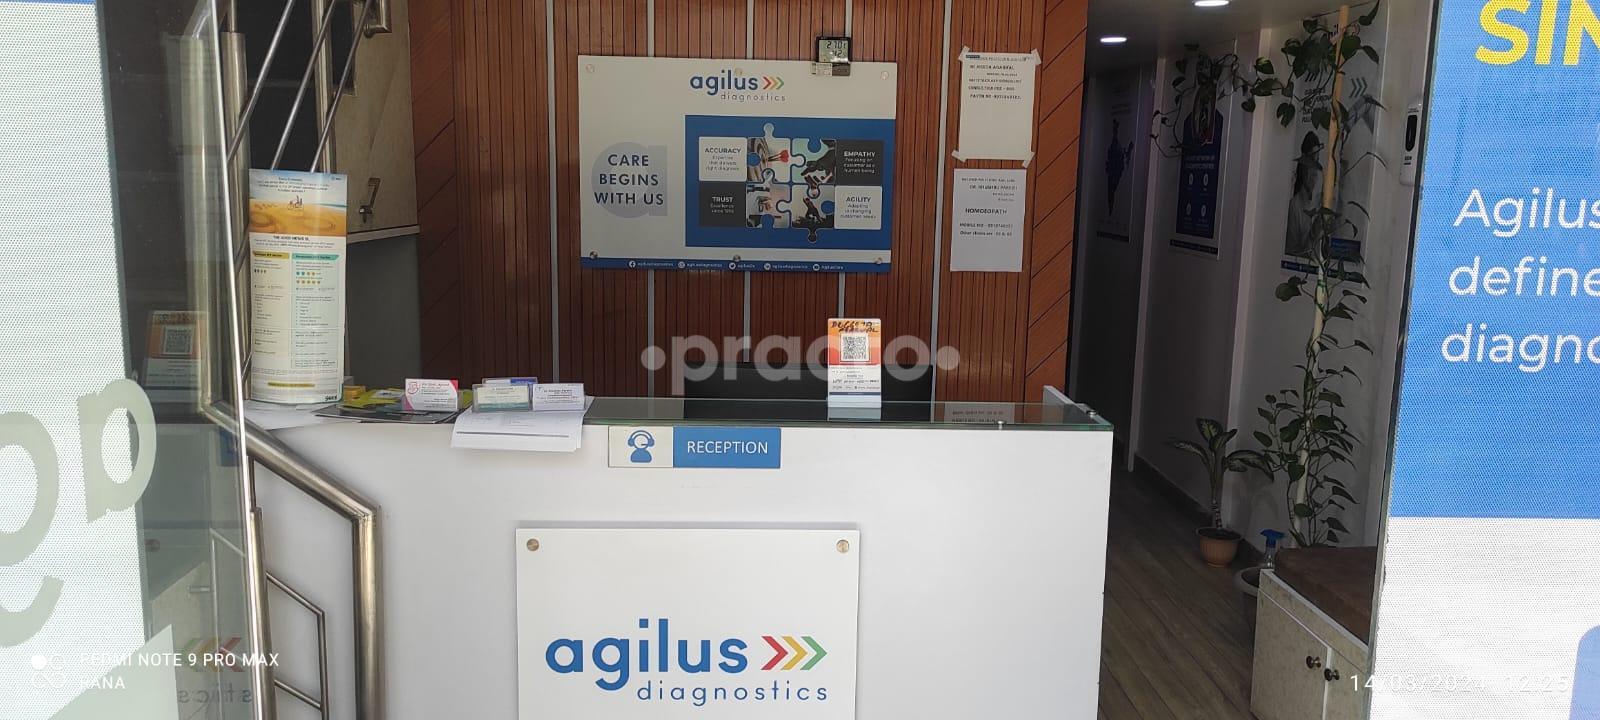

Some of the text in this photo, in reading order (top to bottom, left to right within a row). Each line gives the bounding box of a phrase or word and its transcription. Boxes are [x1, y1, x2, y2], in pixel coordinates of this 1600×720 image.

[690, 69, 758, 95] agilus
[721, 93, 786, 103] diagnostics
[607, 154, 649, 167] CARE
[599, 173, 659, 186] BEGINS
[594, 191, 665, 206] WITH US
[687, 440, 769, 454] RECEPTION
[545, 618, 748, 691] agilus
[637, 680, 828, 706] diagnostics
